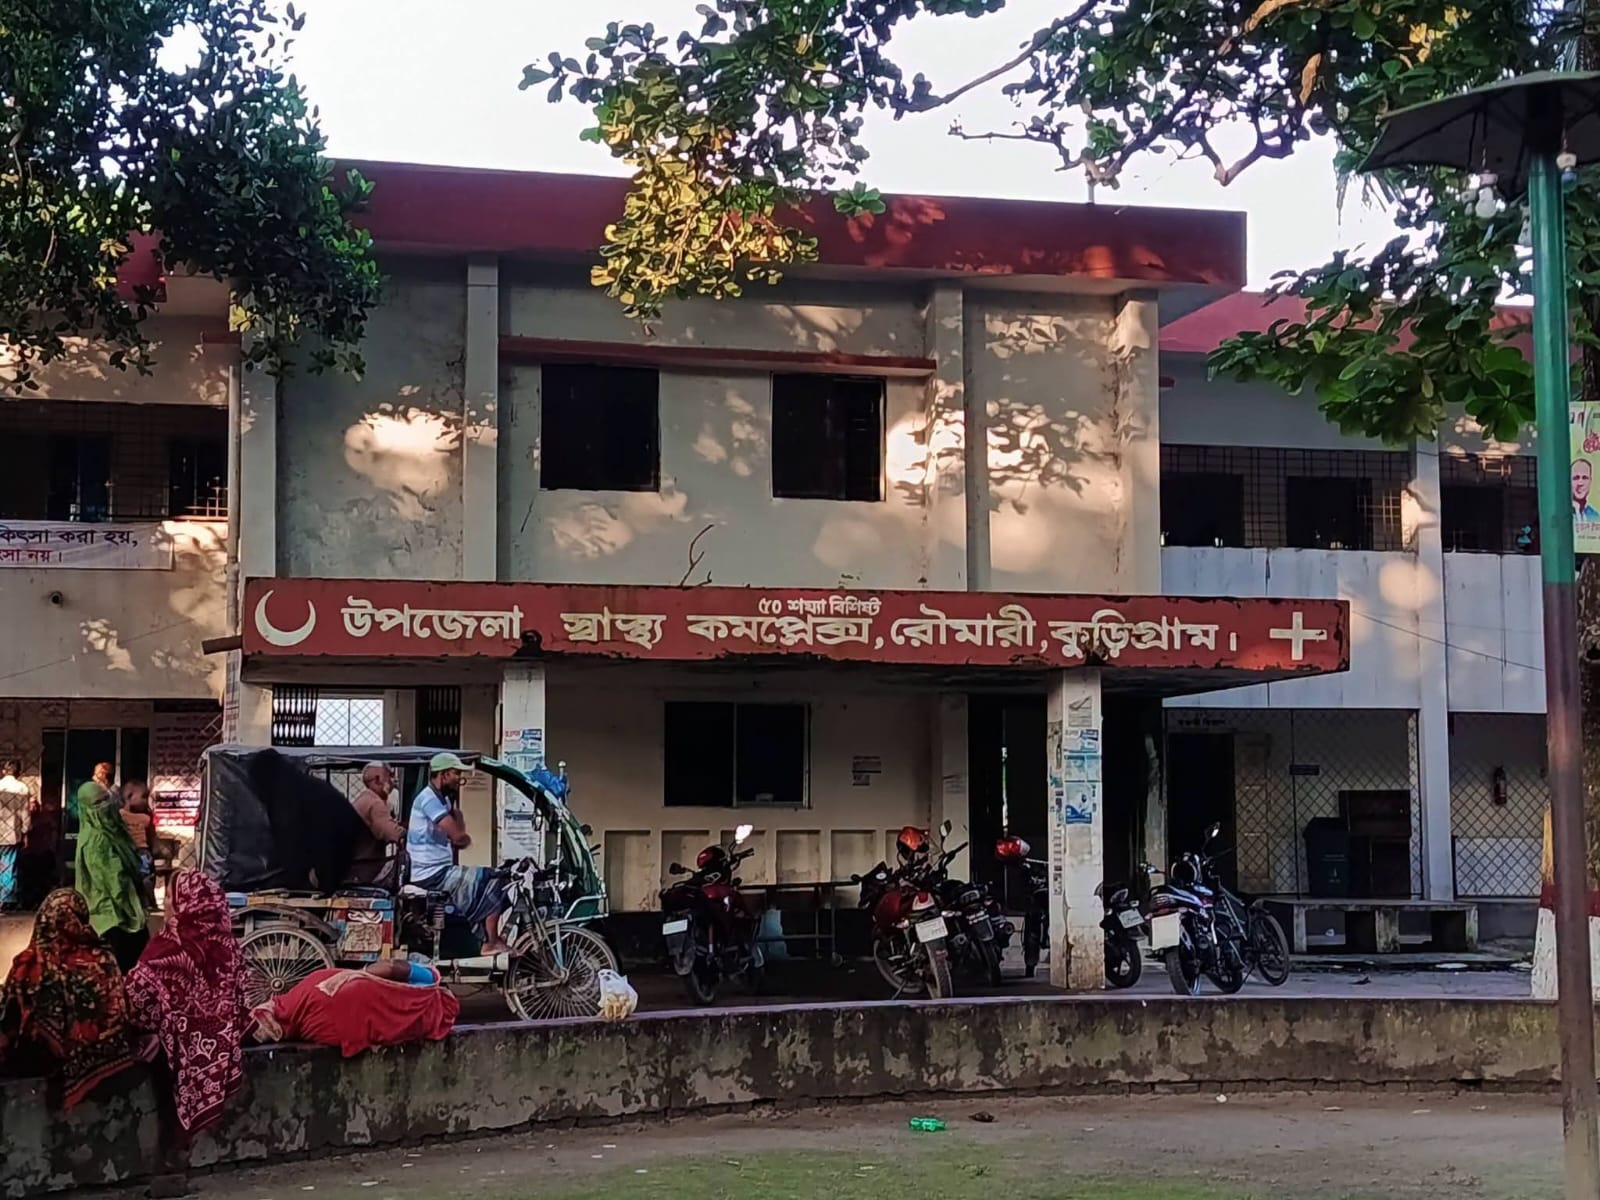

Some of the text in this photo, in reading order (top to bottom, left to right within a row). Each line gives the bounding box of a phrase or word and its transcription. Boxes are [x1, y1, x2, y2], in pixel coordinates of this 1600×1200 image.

[56, 529, 95, 544] করা
[102, 529, 138, 547] হয়,
[27, 550, 53, 563] নয়
[759, 598, 782, 614] ৫০
[829, 595, 882, 616] বিশিষ্ট
[340, 595, 524, 640] উপজেলা
[560, 606, 667, 650] স্বাস্থ্য
[686, 614, 884, 650] কমপ্লেক্স,
[890, 603, 1049, 653] রৌমারী,
